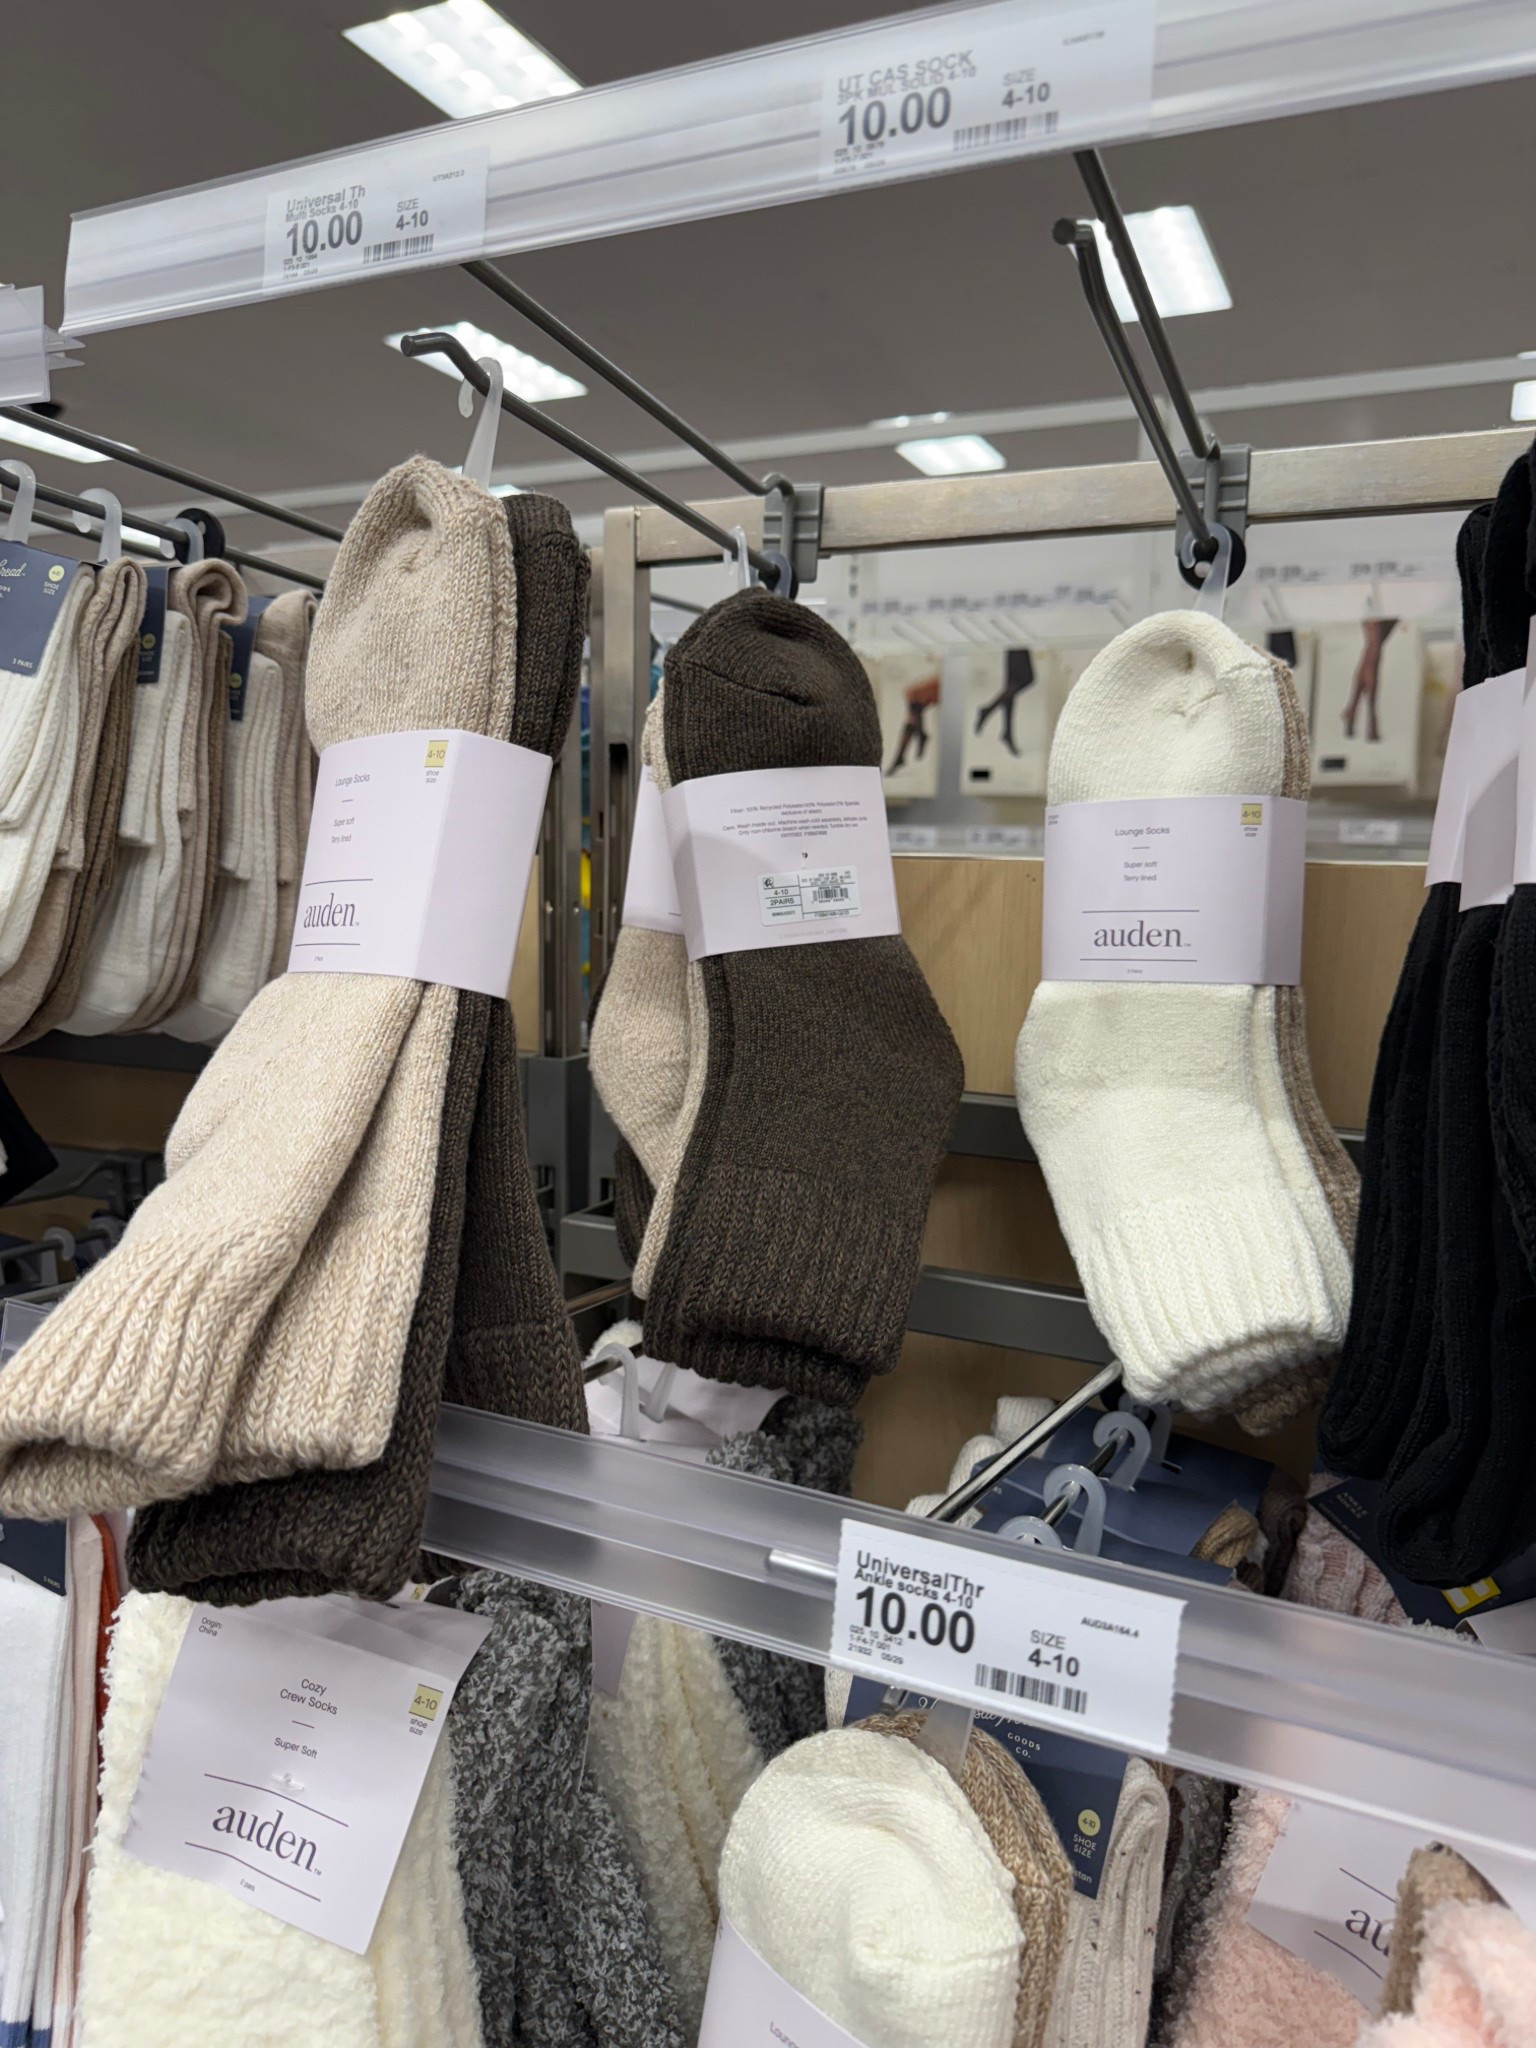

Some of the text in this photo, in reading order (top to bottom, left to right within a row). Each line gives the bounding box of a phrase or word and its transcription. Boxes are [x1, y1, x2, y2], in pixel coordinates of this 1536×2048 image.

[838, 49, 974, 94] UT CAS SOCK
[900, 73, 945, 92] SOLID
[948, 65, 977, 82] 4-10
[1002, 67, 1036, 87] SIZE
[1002, 82, 1050, 109] 4-10
[838, 86, 952, 146] 10.00
[286, 184, 366, 213] Universal Th
[396, 198, 419, 213] SIZE
[309, 204, 336, 217] Socks
[339, 199, 359, 211] 4-10
[396, 210, 429, 231] 4-10
[286, 210, 363, 257] 10.00
[43, 581, 60, 590] SHOE
[17, 660, 33, 669] PAIRS
[427, 749, 445, 760] 4-10
[335, 772, 370, 788] Lounge Socks
[425, 769, 439, 777] shoe
[333, 818, 345, 828] Super
[1241, 810, 1261, 819] 4-10
[1114, 826, 1170, 838] Lounge Socks
[1123, 860, 1157, 870] Super soft
[1123, 874, 1157, 883] Terry lined
[774, 888, 789, 896] 4-10
[303, 892, 356, 929] auden
[770, 897, 795, 907] 2PAIRS
[1093, 919, 1183, 948] auden
[857, 1550, 984, 1599] UniversalThr
[854, 1568, 974, 1610] Ankle socks 4-10
[201, 1616, 224, 1630] Origin:
[856, 1585, 975, 1654] 10.00
[198, 1625, 218, 1637] China
[1030, 1629, 1067, 1650] SIZE
[1028, 1648, 1080, 1677] 4-10
[300, 1678, 327, 1697] Cozy
[279, 1688, 338, 1715] Crew Socks
[414, 1694, 438, 1711] 4-10
[408, 1726, 424, 1737] size
[409, 1717, 428, 1730] shoe
[274, 1737, 319, 1760] Super Soft
[1007, 1731, 1041, 1751] GOODS
[1015, 1746, 1031, 1759] CO.
[1082, 1817, 1096, 1829] 4-10
[212, 1805, 317, 1872] auden
[1073, 1833, 1098, 1851] SHOE
[1073, 1844, 1092, 1859] SIZE
